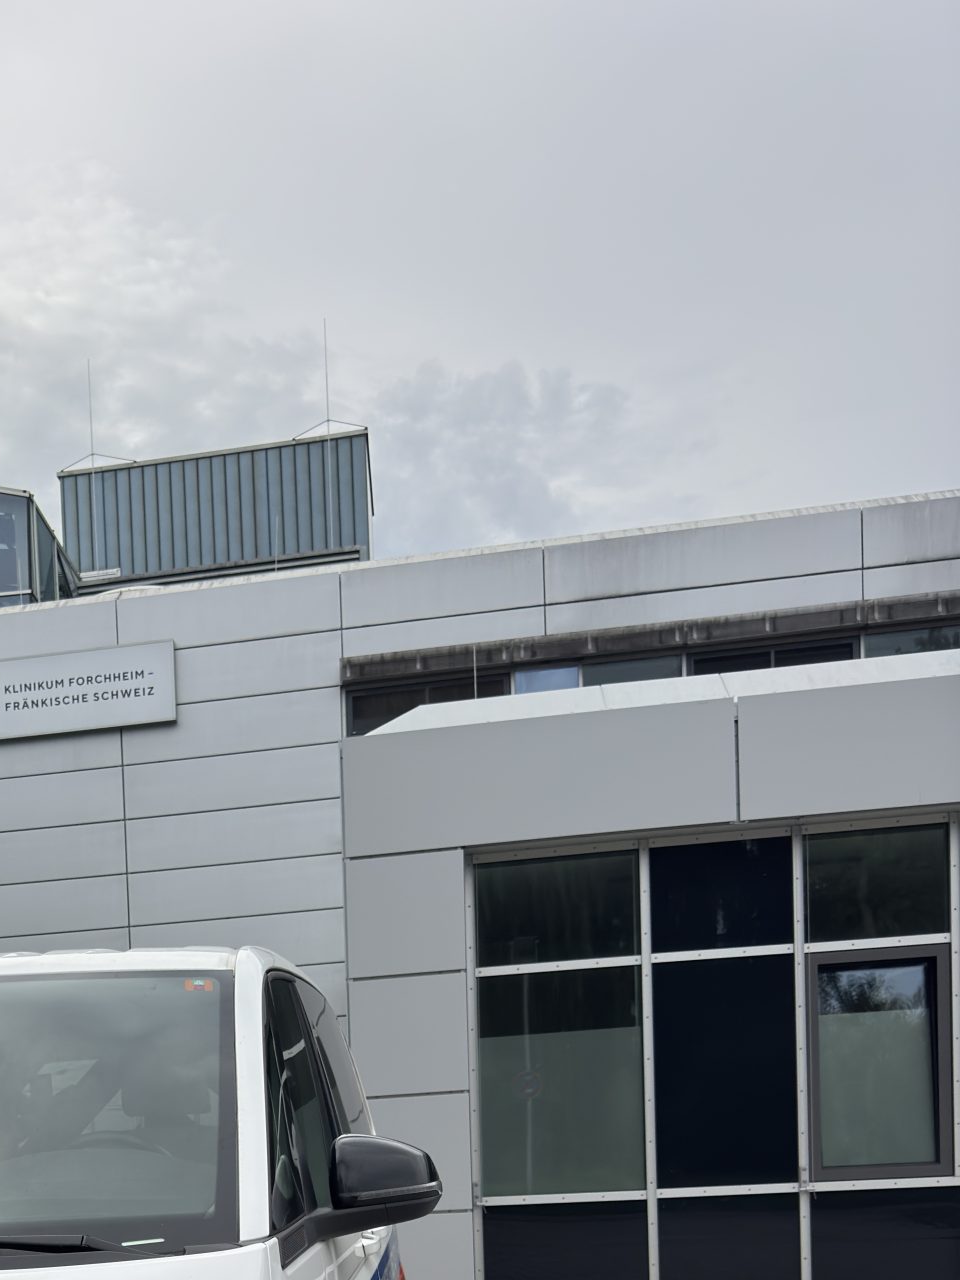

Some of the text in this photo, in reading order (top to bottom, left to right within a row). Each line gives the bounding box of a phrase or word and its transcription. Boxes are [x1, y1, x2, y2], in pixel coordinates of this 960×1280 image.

[4, 679, 65, 695] KLINIKUM
[69, 670, 145, 687] FORCHHEIM
[5, 686, 155, 711] FRÄNKISCHE SCHWEIZ
